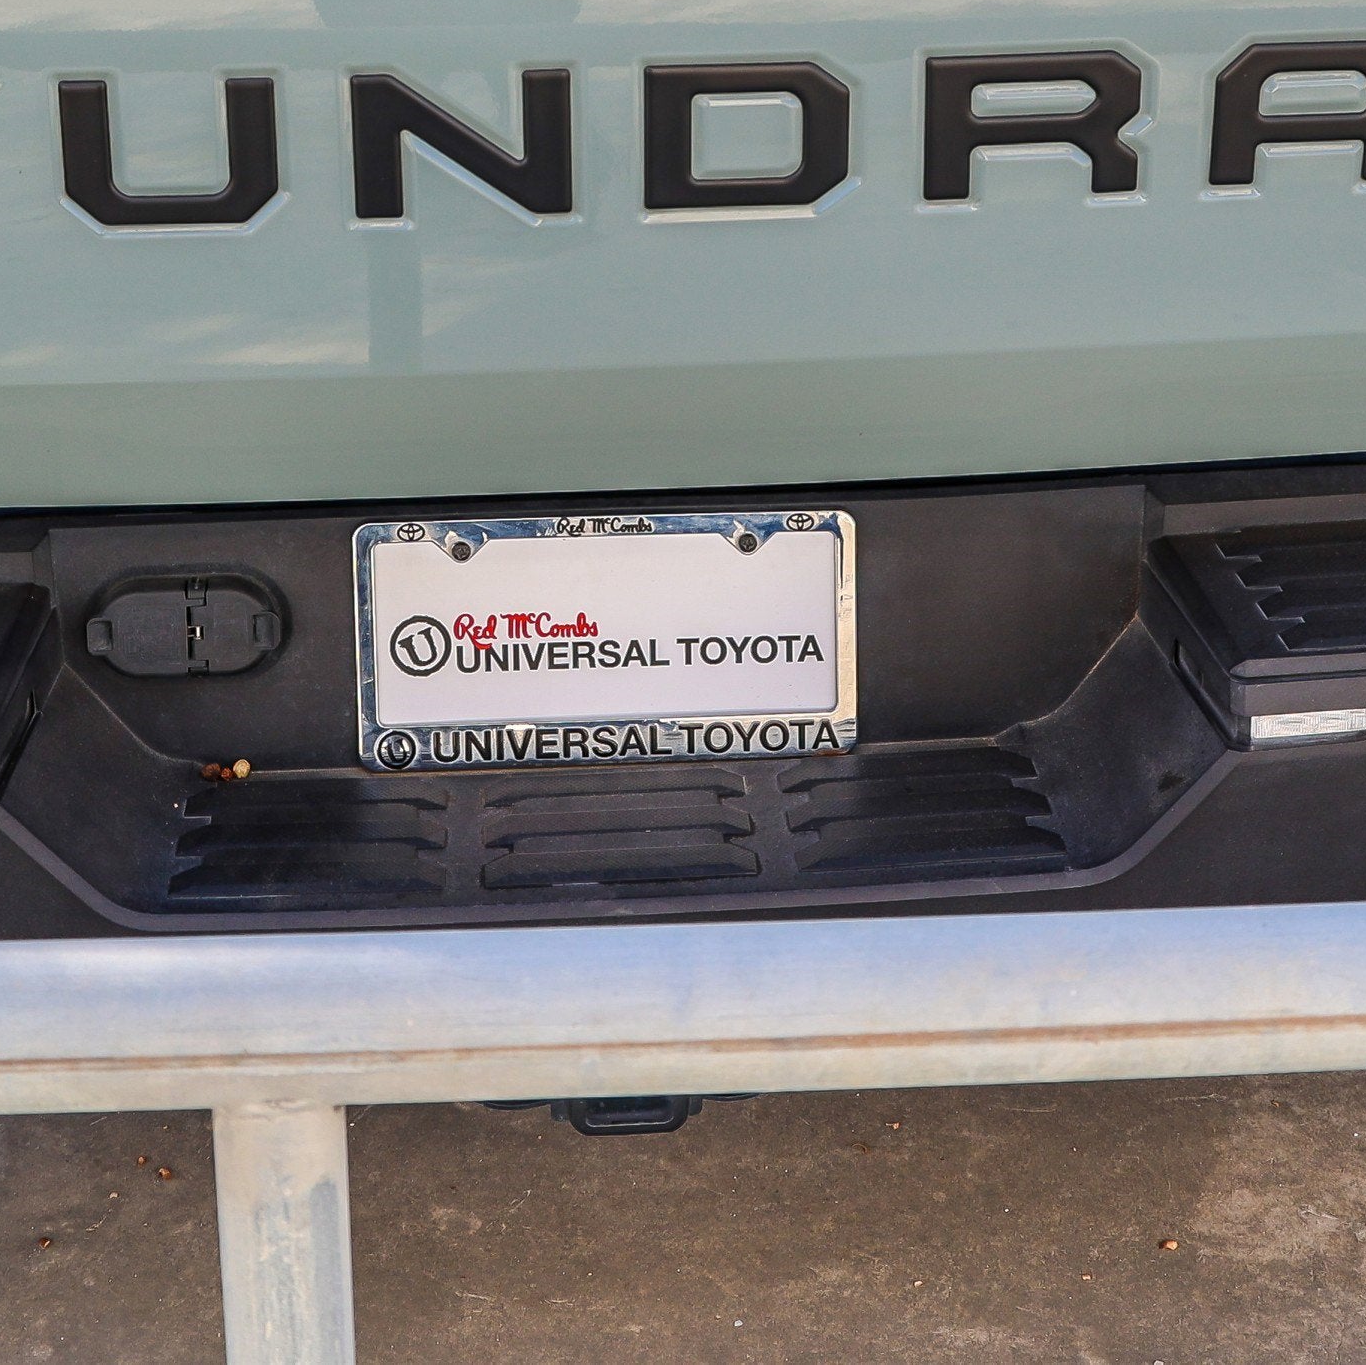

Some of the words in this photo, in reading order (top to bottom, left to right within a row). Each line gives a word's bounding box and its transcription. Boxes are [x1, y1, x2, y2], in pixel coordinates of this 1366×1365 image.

[556, 516, 586, 537] Red
[587, 516, 653, 534] McCombs
[453, 613, 497, 650] Red
[500, 612, 598, 639] McCombs
[456, 640, 670, 673] UNIVERSAL
[677, 634, 824, 666] TOYOTA
[432, 726, 672, 763] UNIVERSAL
[681, 718, 840, 753] TOYOTA
